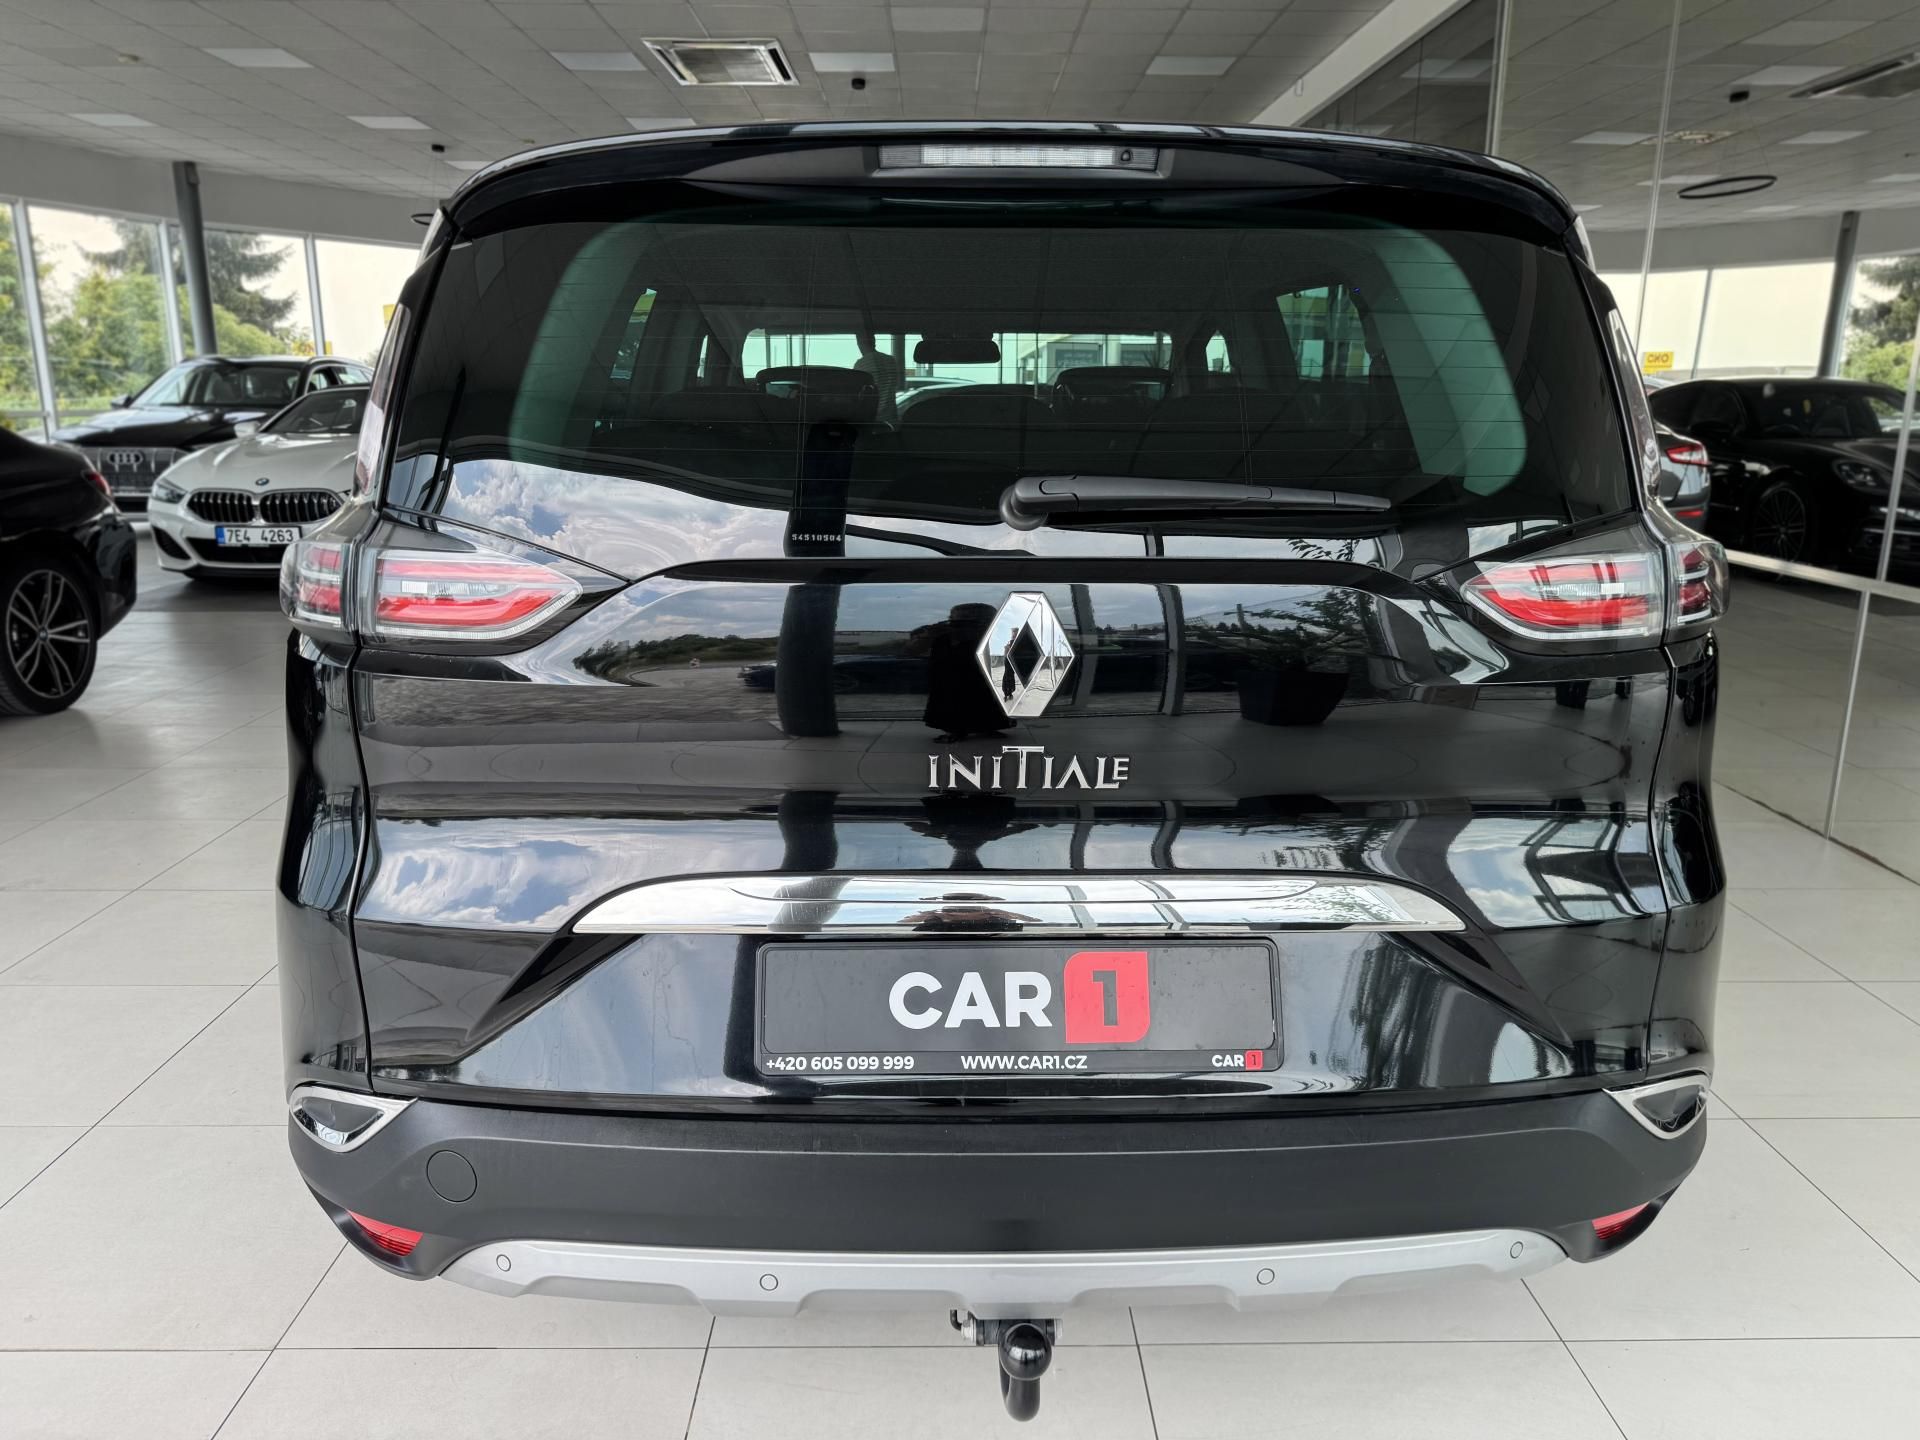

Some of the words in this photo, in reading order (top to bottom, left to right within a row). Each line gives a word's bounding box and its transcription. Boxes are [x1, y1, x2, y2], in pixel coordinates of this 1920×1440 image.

[226, 529, 250, 542] 7E4
[261, 529, 294, 542] 4263
[928, 745, 1130, 790] INITIALE
[888, 971, 1053, 1030] CAR
[766, 1056, 807, 1071] +420
[811, 1056, 843, 1071] 605
[846, 1056, 879, 1070] 099
[883, 1056, 915, 1070] 999
[960, 1055, 1088, 1070] WWW.CAR1.CZ
[1211, 1054, 1245, 1068] CAR
